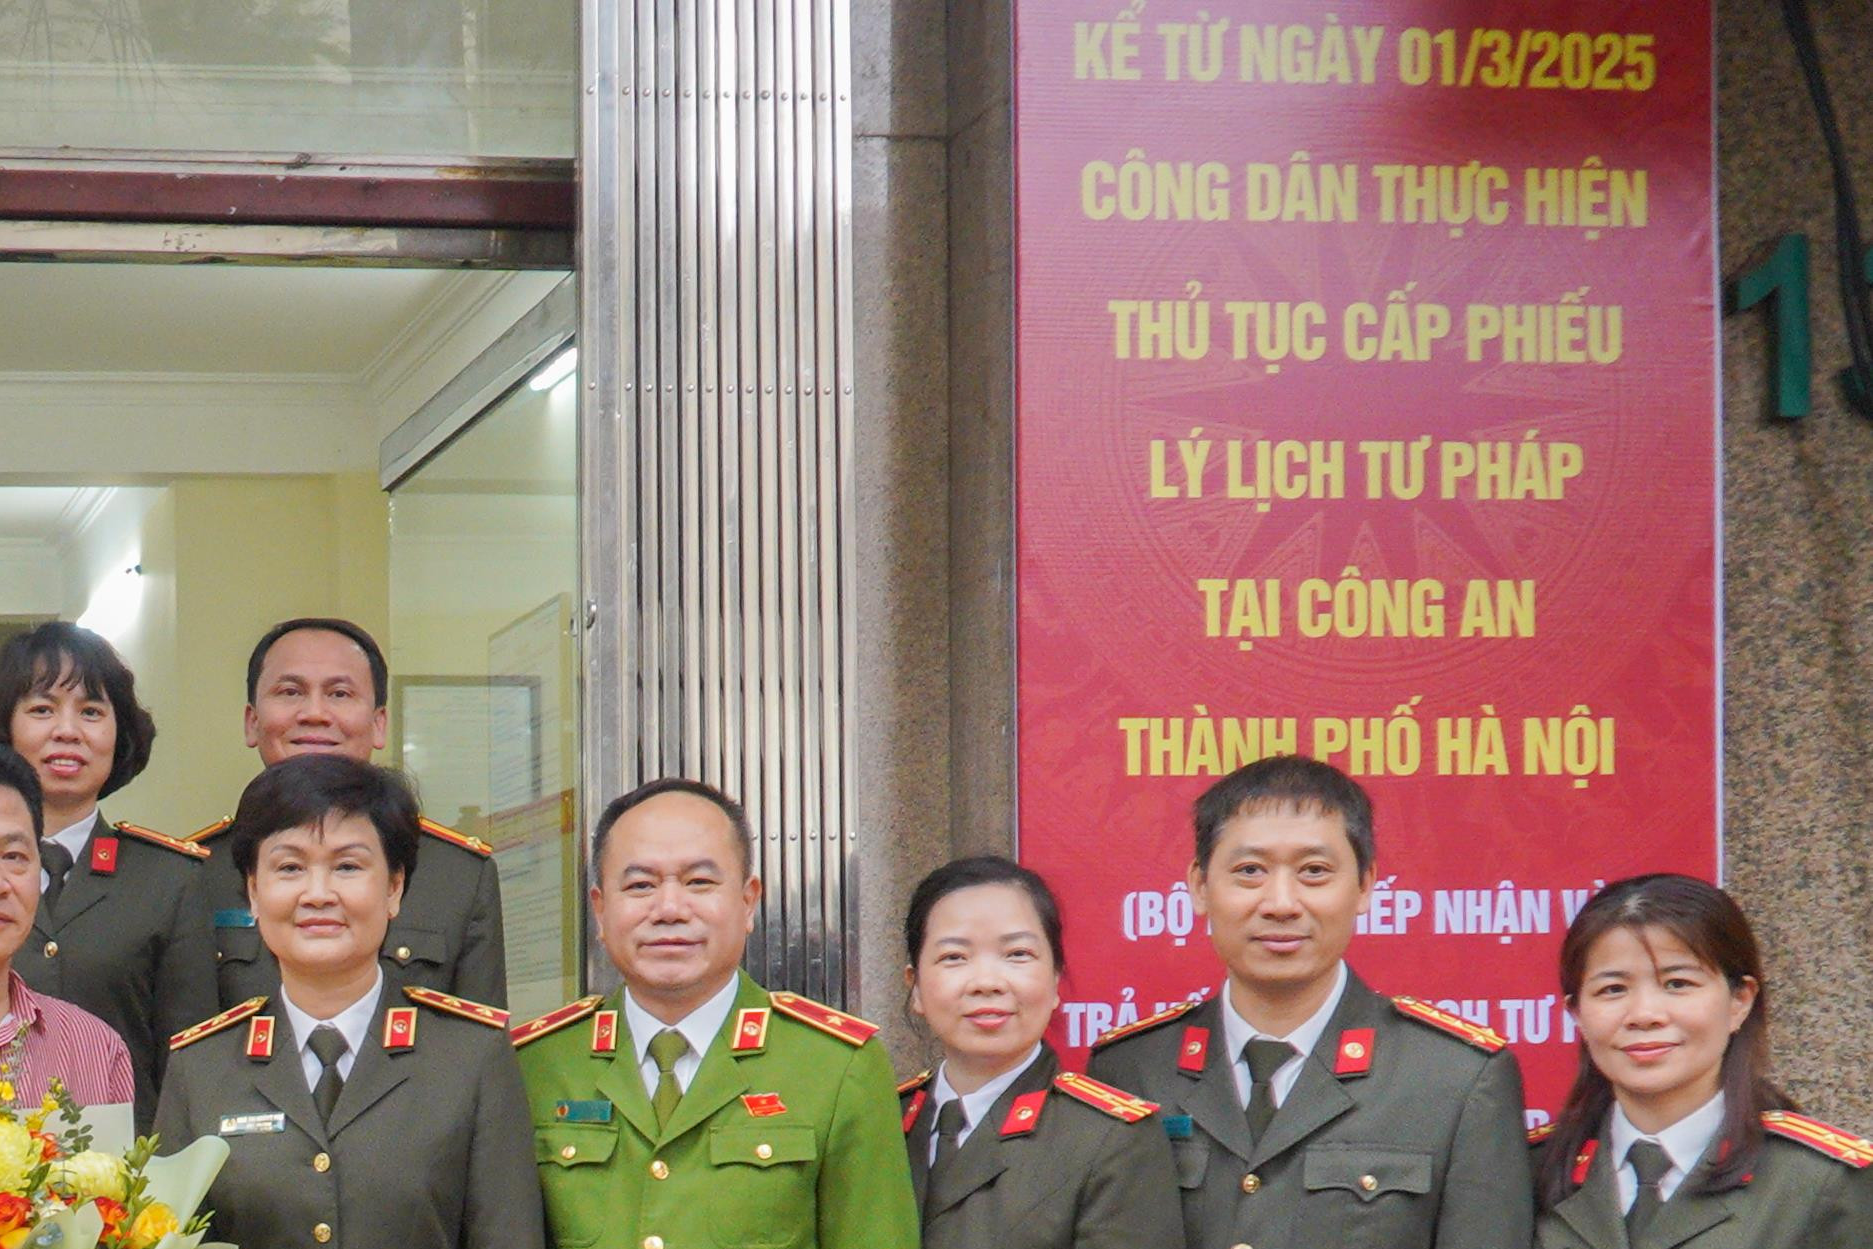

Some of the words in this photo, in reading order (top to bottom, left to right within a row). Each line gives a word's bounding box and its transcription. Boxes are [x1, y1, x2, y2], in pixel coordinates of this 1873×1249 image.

[1160, 11, 1231, 83] TỪ
[1240, 16, 1386, 87] NGÀY
[1399, 28, 1657, 92] 01/3/2025
[1080, 149, 1230, 222] CÔNG
[1245, 150, 1358, 225] DÂN
[1372, 159, 1509, 238] THỰC
[1524, 157, 1649, 240] HIỆN
[1108, 281, 1209, 361] THỦ
[1224, 301, 1327, 374] TỤC
[1343, 282, 1451, 362] CẤP
[1466, 286, 1623, 365] PHIẾU
[1149, 427, 1209, 500] LÝ
[1226, 440, 1345, 512] LỊCH
[1361, 436, 1432, 500] TƯ
[1442, 430, 1584, 501] PHÁP
[1198, 577, 1281, 650] TẠI
[1297, 566, 1445, 639] CÔNG
[1460, 579, 1536, 638] AN
[1118, 704, 1297, 777] THÀNH
[1313, 695, 1422, 777] PHỐ
[1437, 700, 1509, 776] HÀ
[1524, 703, 1616, 790] NỘI
[1123, 881, 1194, 947] (BỘ
[1434, 879, 1551, 944] NHẬN
[1062, 987, 1140, 1047] TRẢ
[1500, 994, 1556, 1044] TƯ
